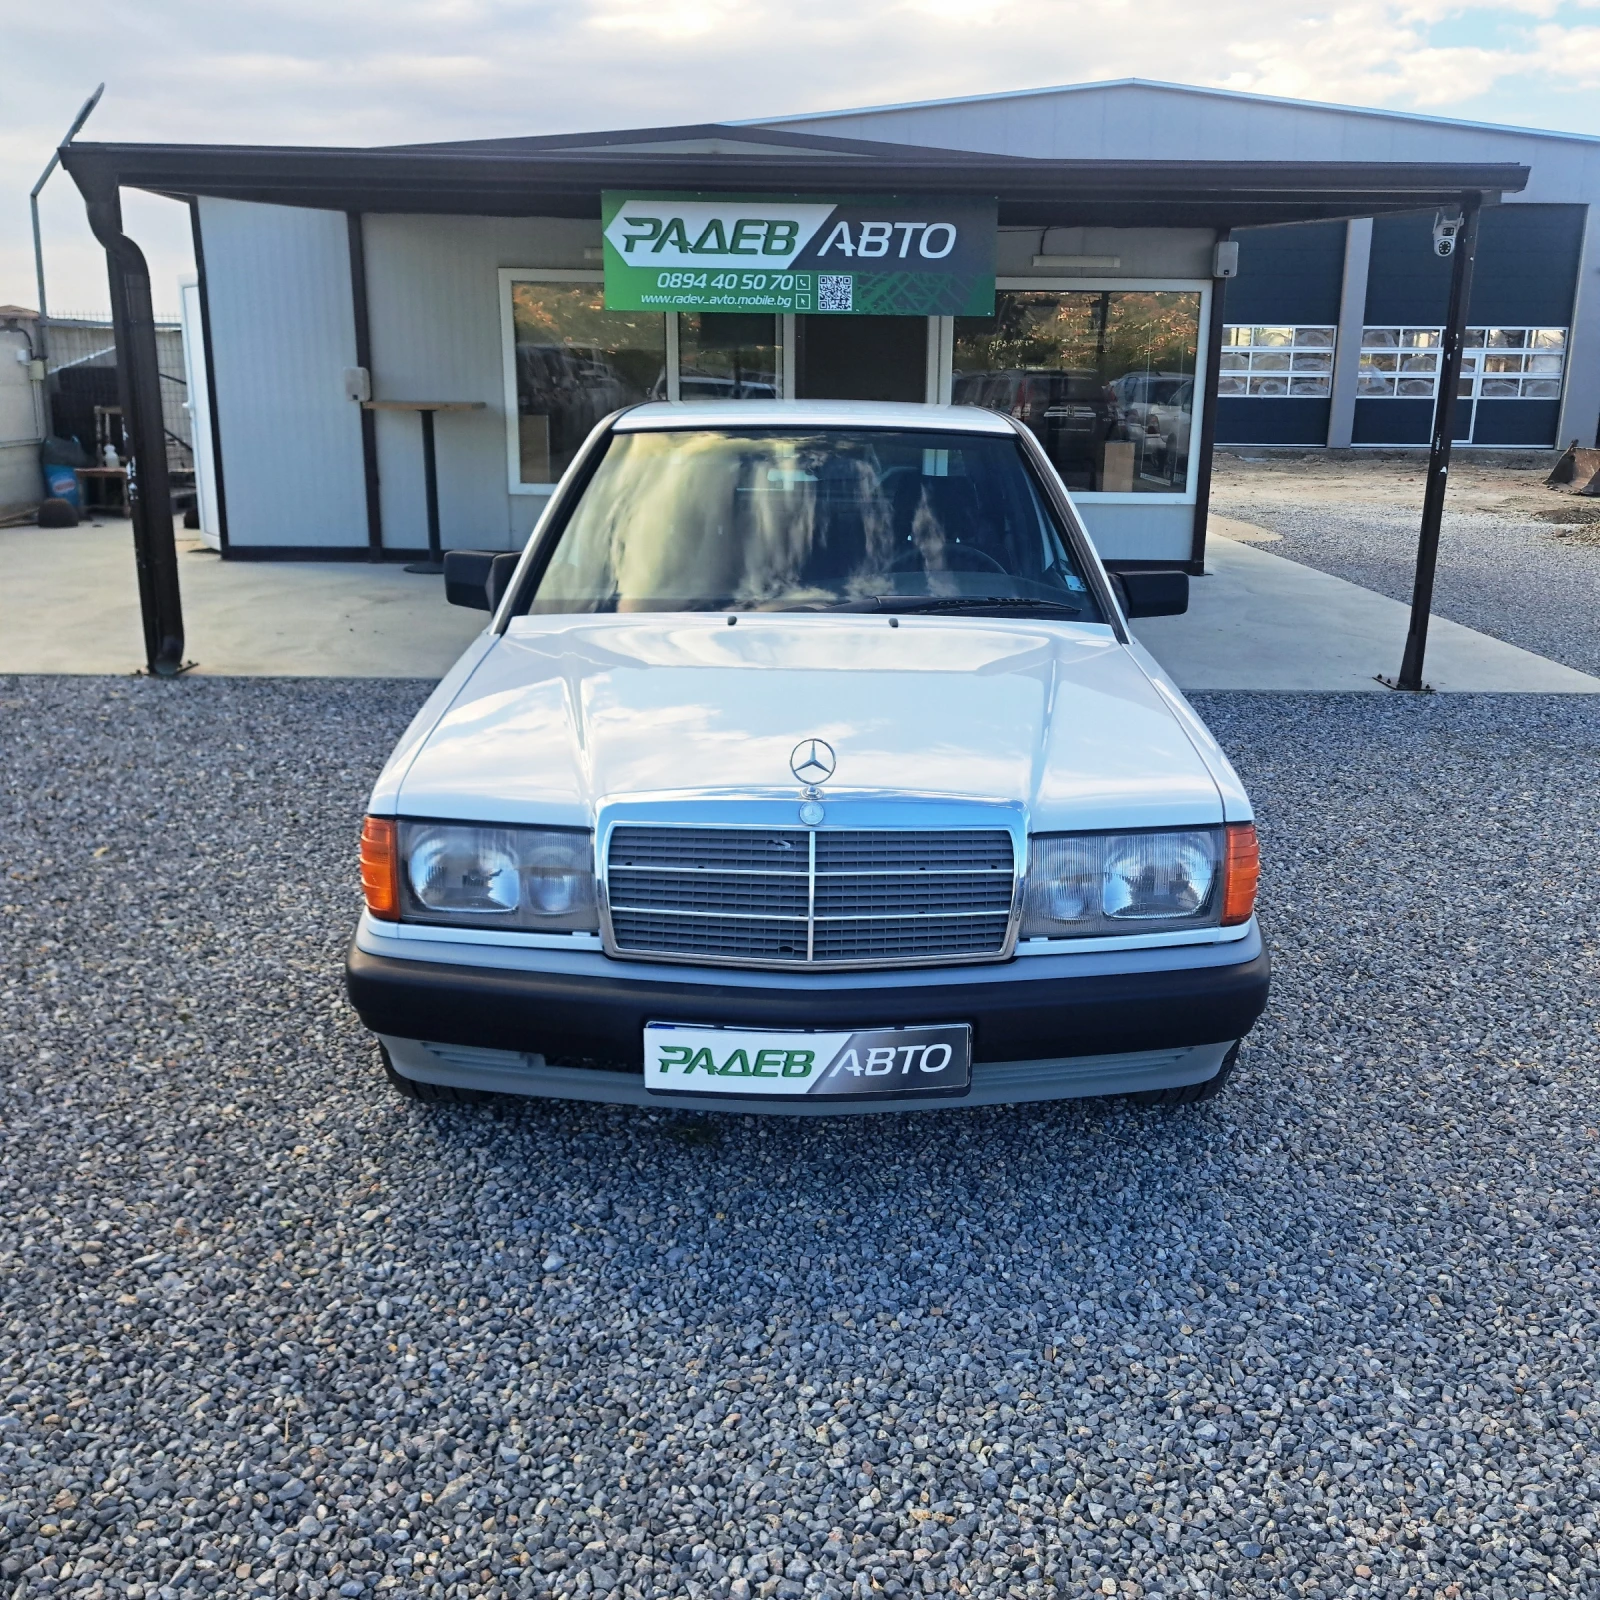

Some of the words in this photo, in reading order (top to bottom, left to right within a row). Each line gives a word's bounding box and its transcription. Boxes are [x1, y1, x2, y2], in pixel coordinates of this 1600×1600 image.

[817, 220, 957, 259] АВТО
[657, 272, 708, 289] 0894
[710, 273, 738, 289] 40
[740, 274, 767, 290] 50
[769, 274, 794, 291] 70
[641, 293, 792, 308] www.radev_avto.mobile.bg
[828, 1043, 952, 1078] АВТО
